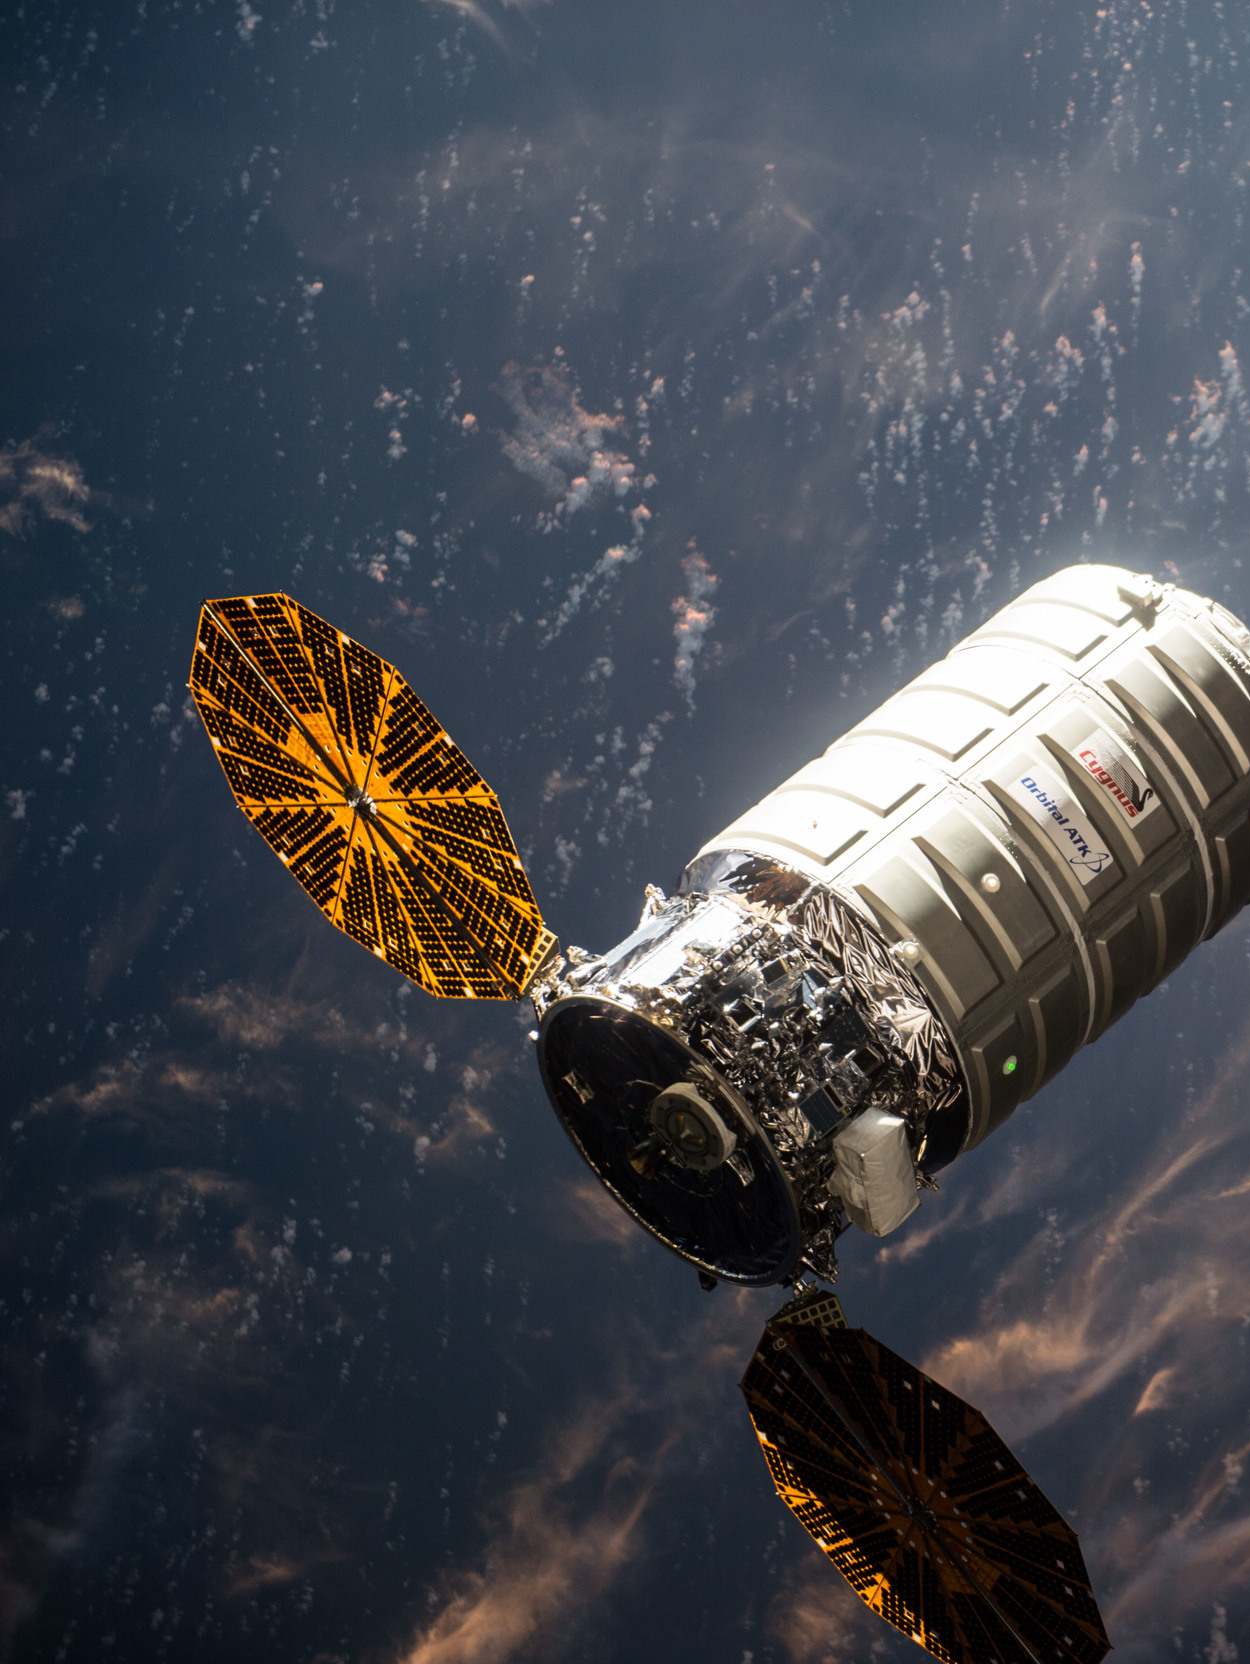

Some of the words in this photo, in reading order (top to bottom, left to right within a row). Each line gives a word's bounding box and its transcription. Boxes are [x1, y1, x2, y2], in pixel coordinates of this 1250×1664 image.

[1020, 776, 1070, 826] Orbital
[1063, 827, 1093, 858] ATK
[1079, 749, 1139, 818] Cygnus
